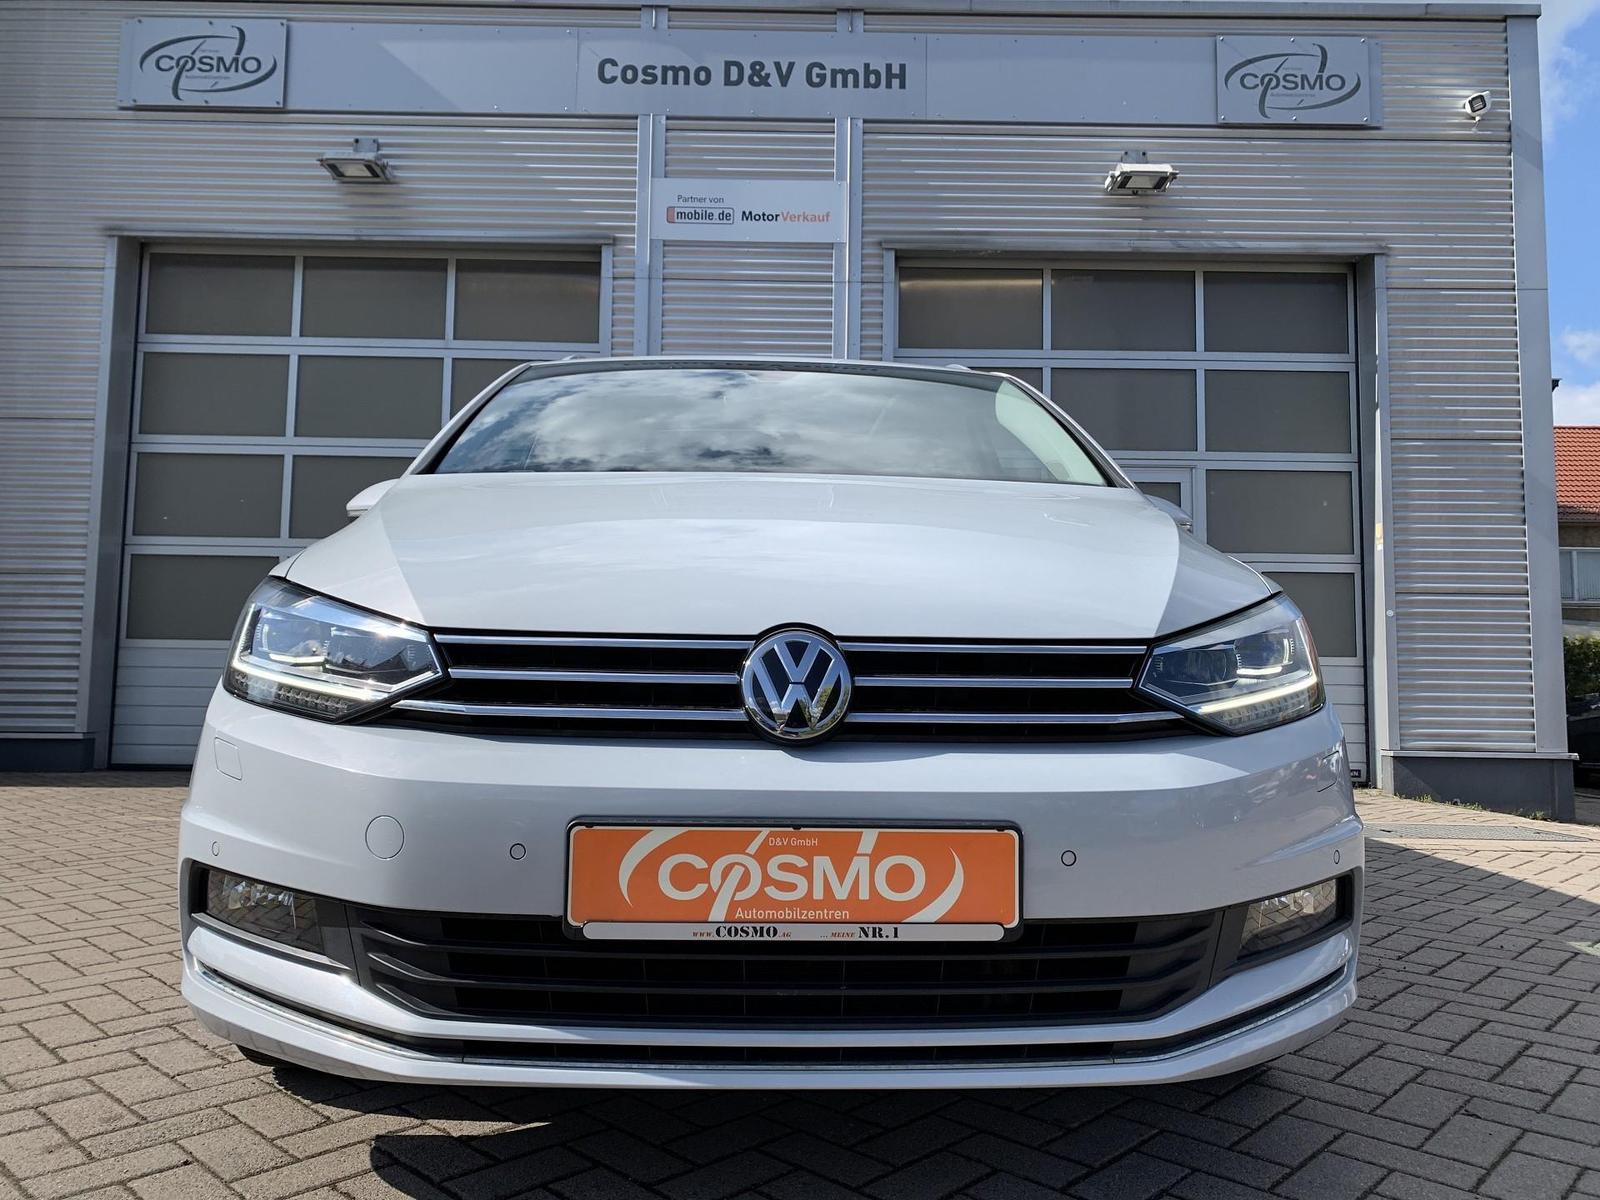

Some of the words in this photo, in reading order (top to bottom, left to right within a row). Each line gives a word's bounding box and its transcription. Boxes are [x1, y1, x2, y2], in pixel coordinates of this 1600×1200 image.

[154, 54, 262, 74] COSMO
[597, 57, 712, 87] Cosmo
[723, 59, 796, 88] D&V
[805, 61, 908, 90] GmbH
[1239, 72, 1346, 91] COSMO
[677, 194, 708, 204] Partner
[709, 196, 725, 204] von
[676, 208, 732, 222] mobile.de
[744, 630, 849, 737] VW
[768, 837, 789, 846] D&V
[790, 837, 818, 847] GmbH
[657, 852, 926, 902] COSMO
[735, 906, 850, 920] Automobilzentren
